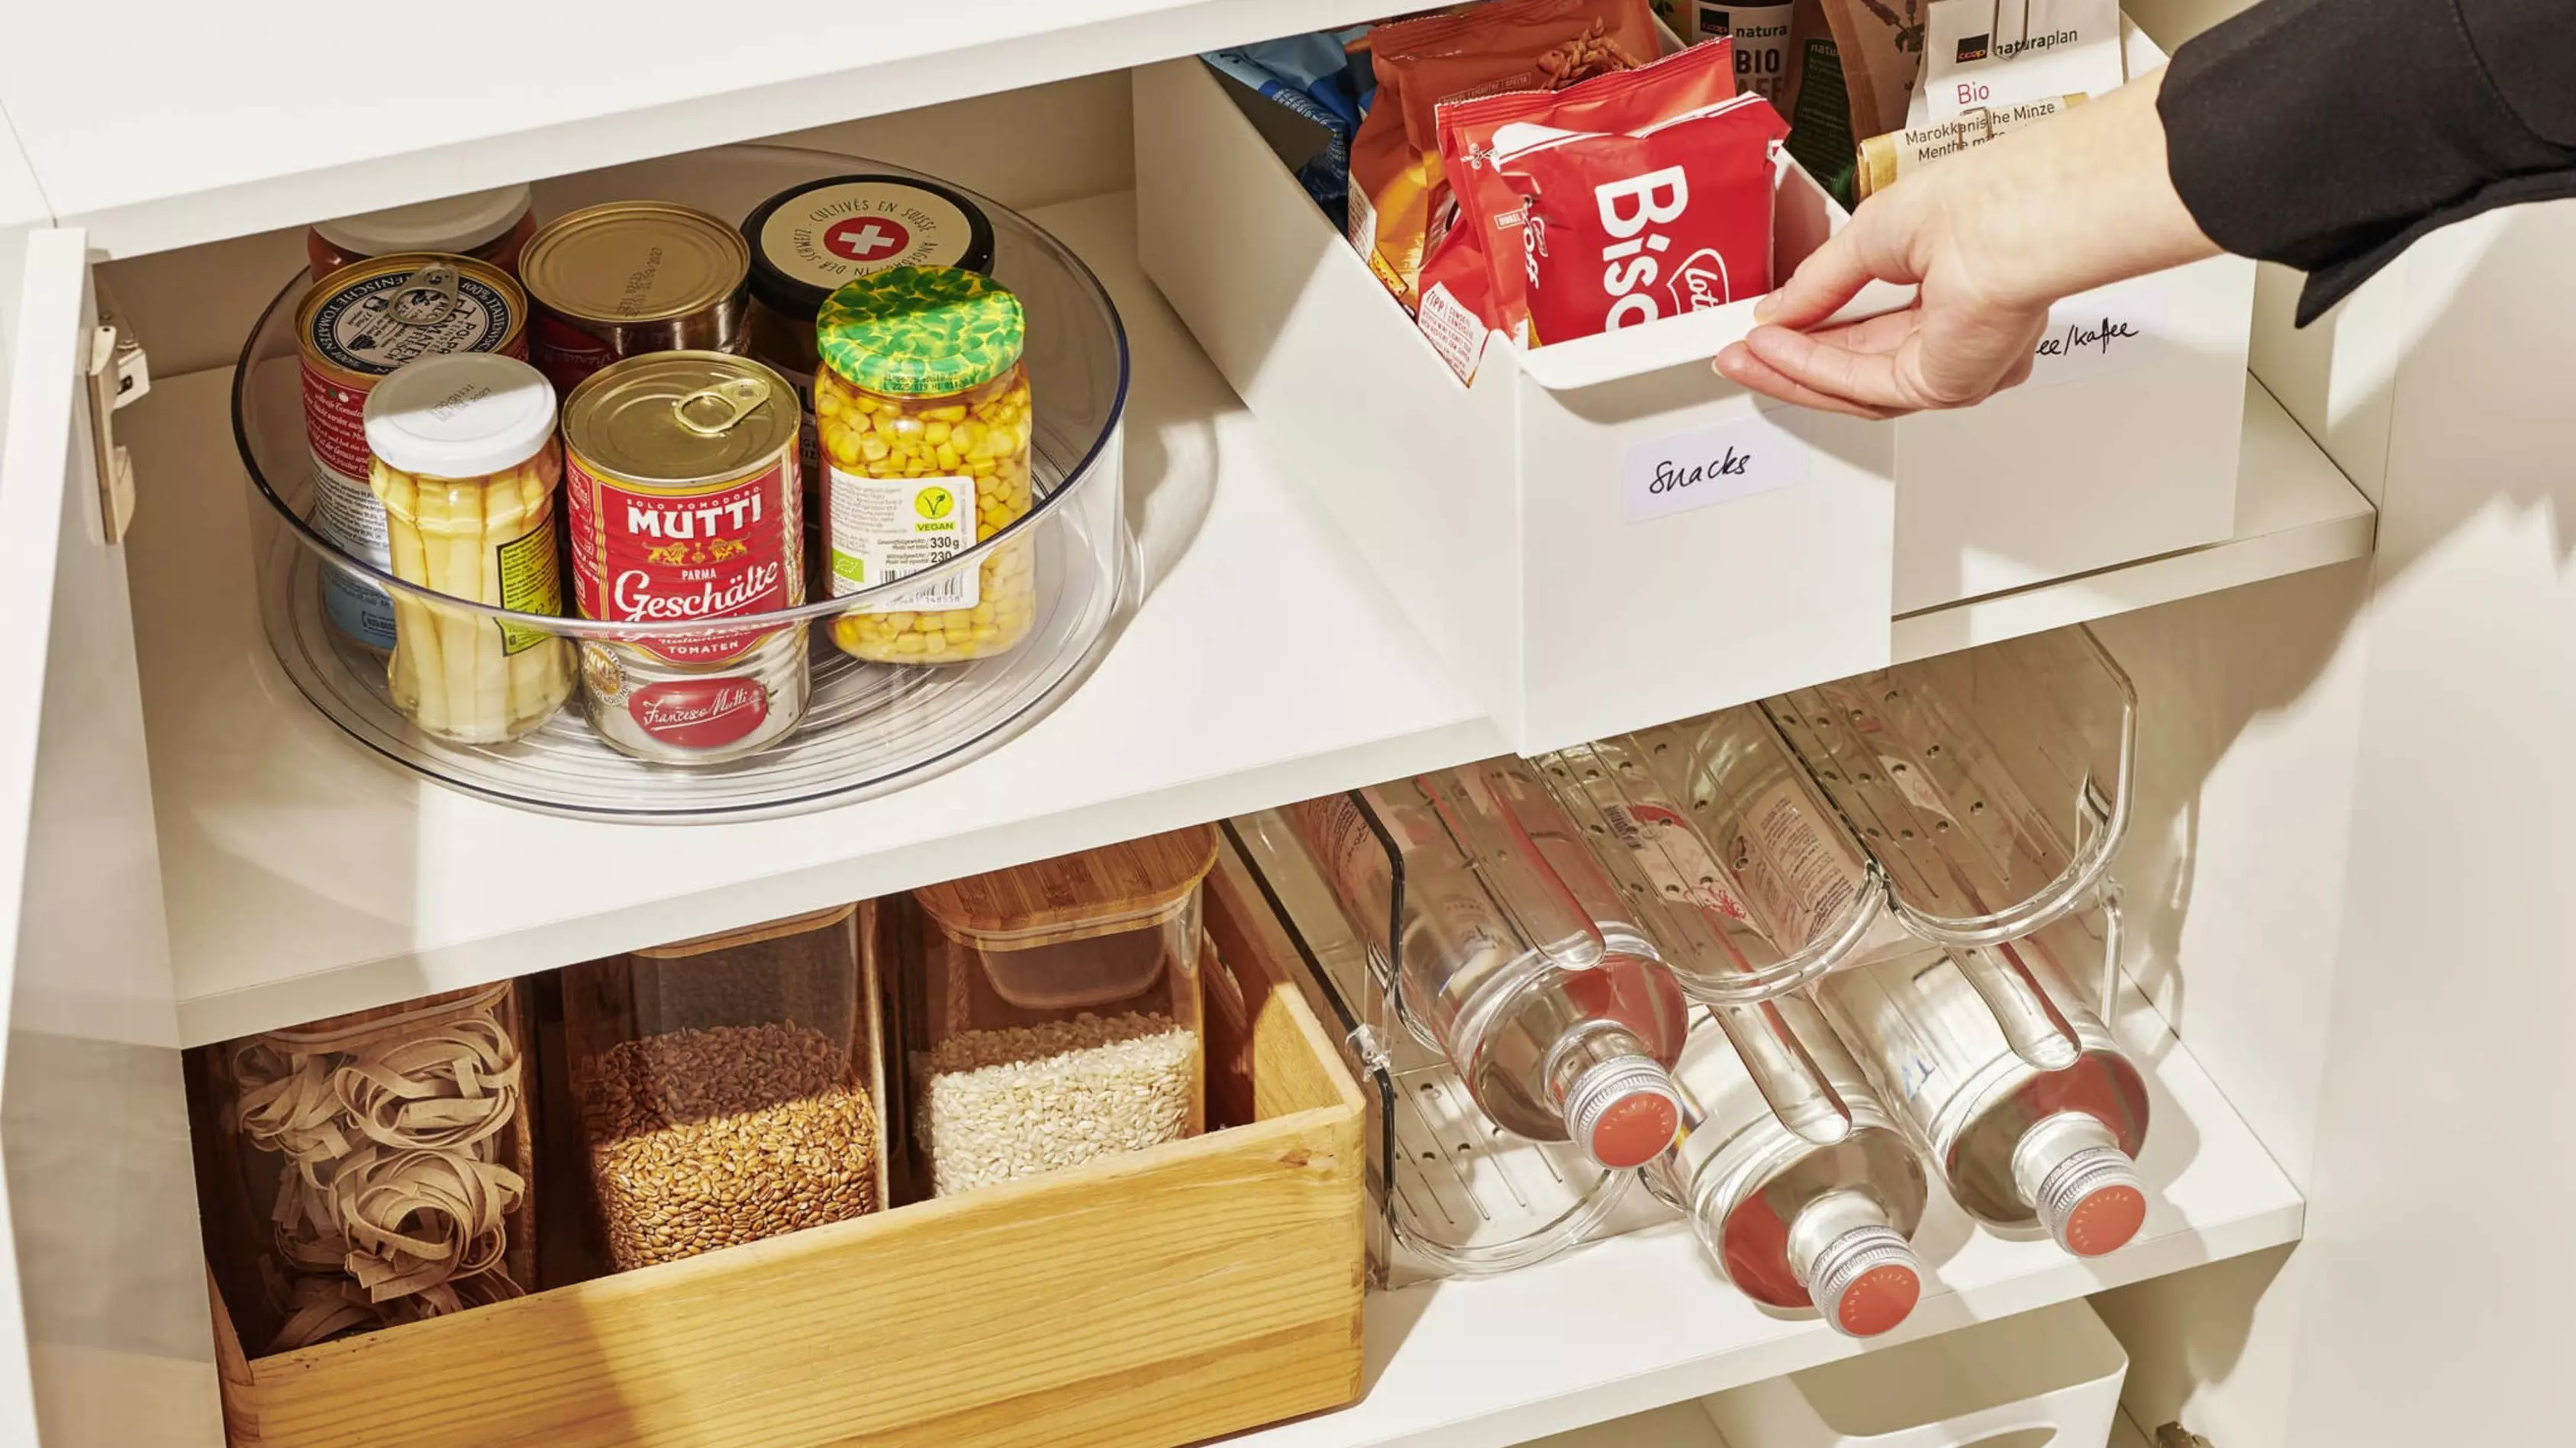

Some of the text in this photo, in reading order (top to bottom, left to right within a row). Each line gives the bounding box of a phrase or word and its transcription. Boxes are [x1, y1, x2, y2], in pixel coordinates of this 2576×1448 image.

[1997, 28, 2078, 56] naturaplan
[1736, 49, 1780, 74] BIO
[1957, 83, 1990, 105] Bio
[1905, 108, 2010, 146] Marokkanishe
[2013, 102, 2055, 122] Minze
[877, 199, 899, 214] EN
[901, 207, 937, 234] SUISSE
[794, 228, 824, 263] SCHWEIZ
[818, 260, 847, 276] DER
[337, 273, 406, 304] ENISCHE
[436, 321, 477, 355] POLPA
[2036, 317, 2139, 356] ee/kaffee
[1649, 445, 1751, 494] Snacks
[626, 498, 666, 511] SOLO
[627, 493, 762, 539] MUTTI
[917, 521, 955, 532] VEGAN
[930, 537, 952, 550] 330
[953, 540, 960, 550] g
[930, 550, 953, 564] 230
[682, 567, 717, 582] PARMA
[614, 560, 779, 623] Geschälte
[669, 640, 739, 655] TOMATEN
[642, 689, 749, 727] Francesco Mutti
